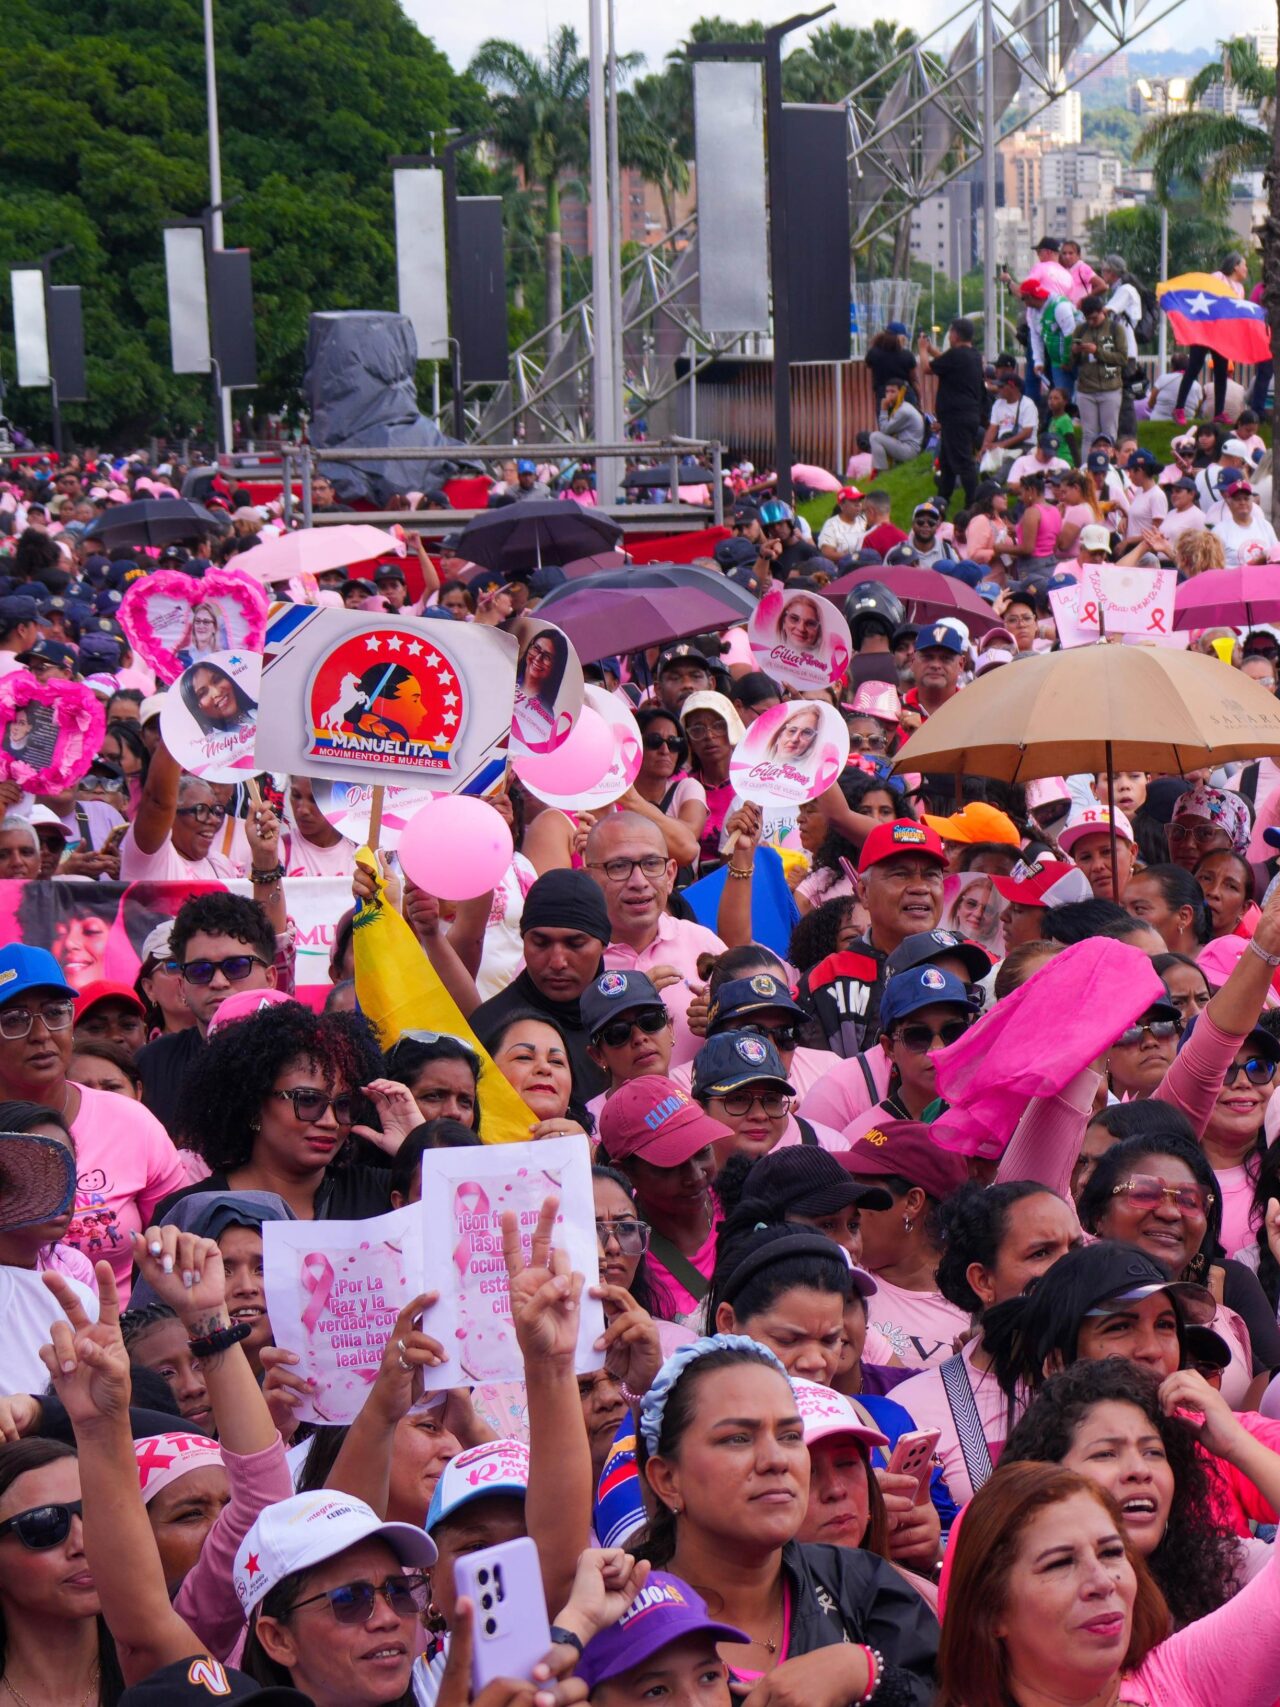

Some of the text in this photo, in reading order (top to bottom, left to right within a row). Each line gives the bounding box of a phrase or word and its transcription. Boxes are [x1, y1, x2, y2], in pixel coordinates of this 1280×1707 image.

[331, 735, 433, 758] MANUELITA
[318, 747, 444, 769] MOVIMIENTO DE MUJERES
[459, 1213, 489, 1233] ¡Con
[470, 1233, 493, 1252] las
[334, 1275, 384, 1298] ¡Por La
[330, 1293, 386, 1314] Paz y la
[317, 1314, 373, 1333] verdad,
[330, 1332, 363, 1350] Cilia
